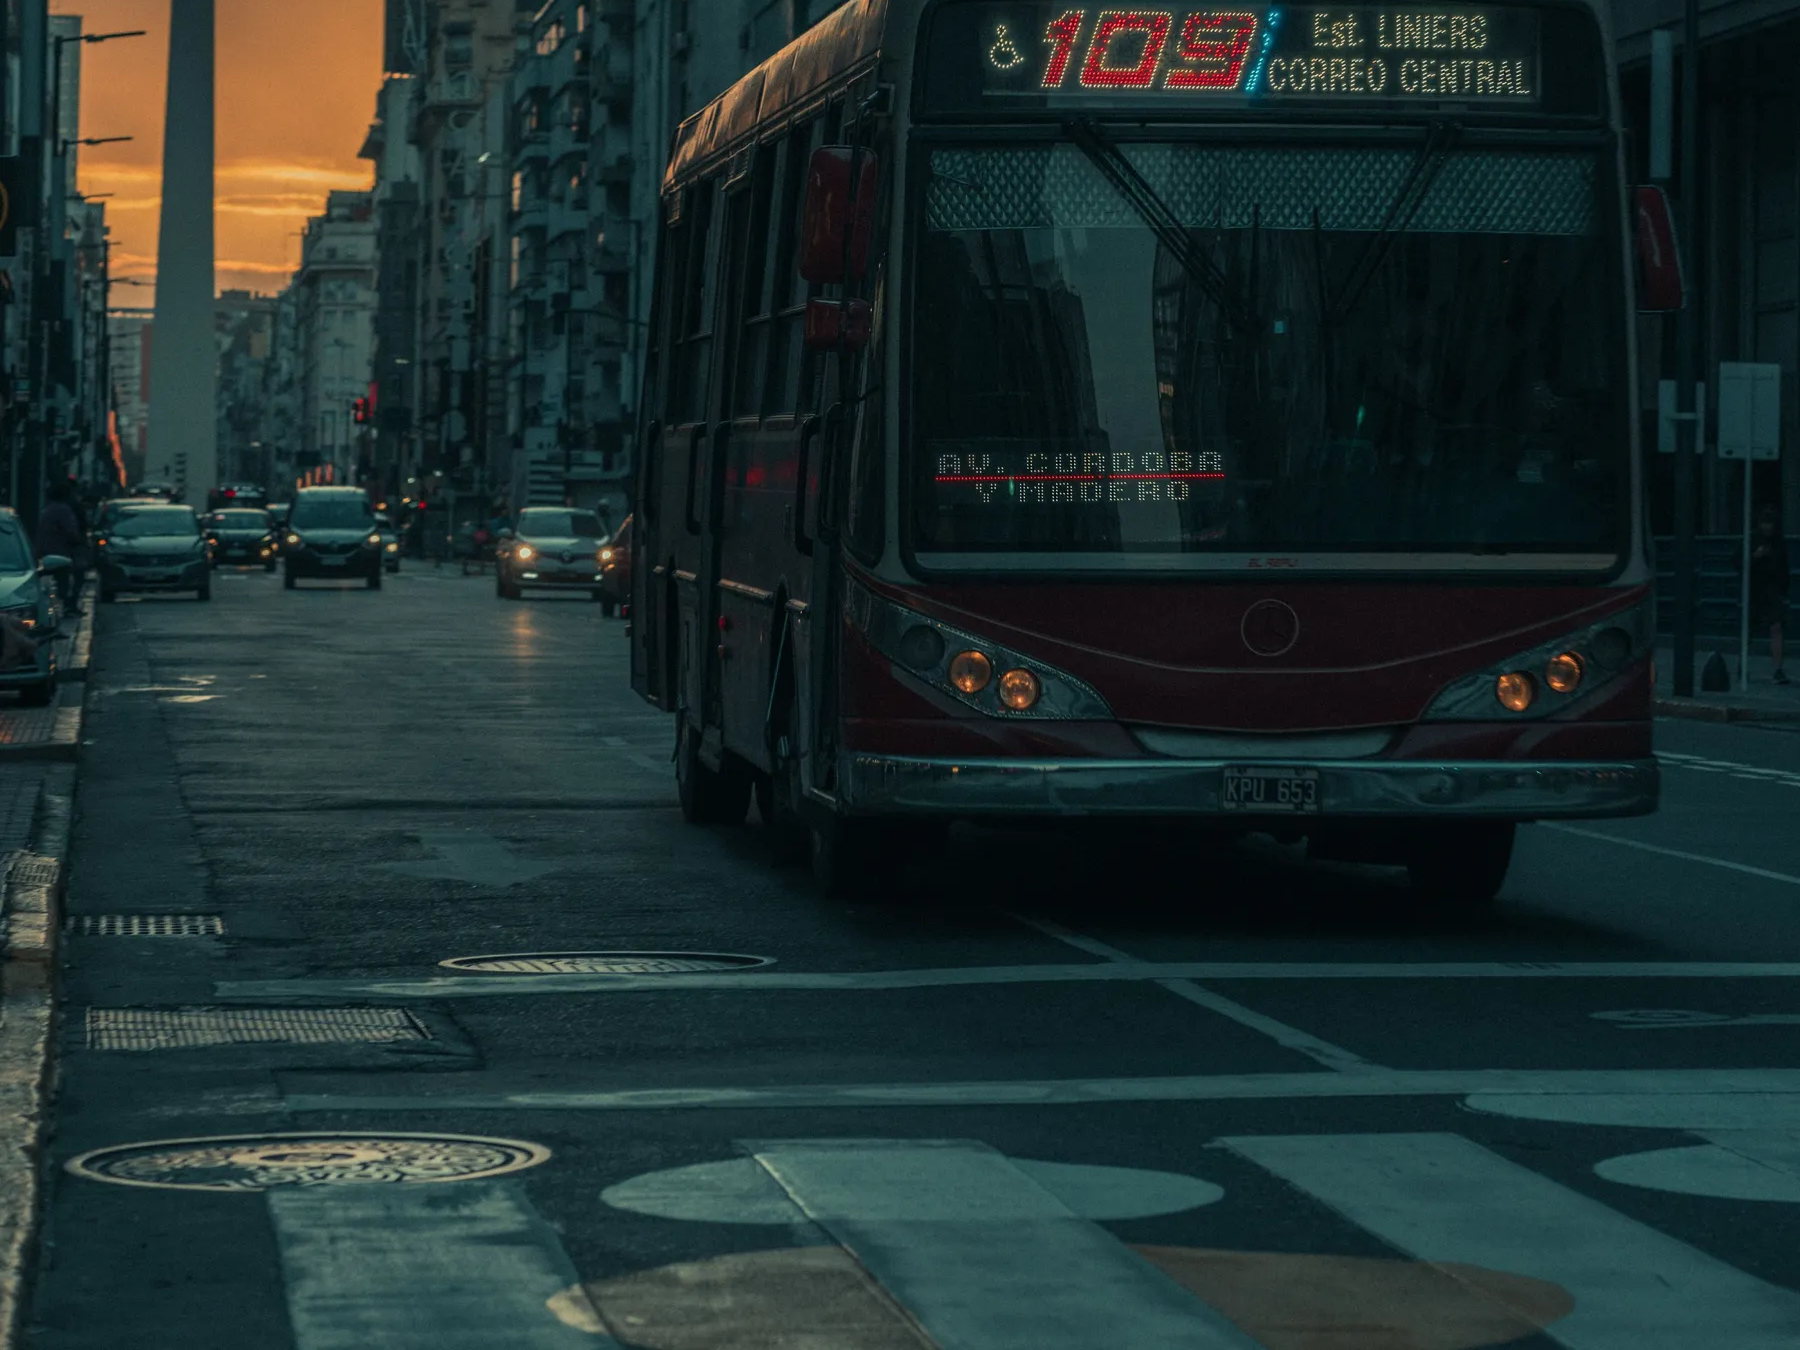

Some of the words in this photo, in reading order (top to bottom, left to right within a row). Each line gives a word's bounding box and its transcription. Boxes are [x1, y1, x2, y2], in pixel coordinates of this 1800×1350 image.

[1314, 13, 1364, 48] Est.
[1379, 14, 1488, 49] LINIERS
[1041, 9, 1258, 90] 109
[1268, 57, 1387, 92] CORREO
[1400, 58, 1531, 94] CENTRAL
[938, 453, 1005, 475] AV.
[1025, 450, 1223, 473] CORDOBA
[975, 482, 997, 503] Y
[1018, 480, 1189, 503] MADERO
[1226, 777, 1266, 802] KPU
[1277, 779, 1316, 804] 653
